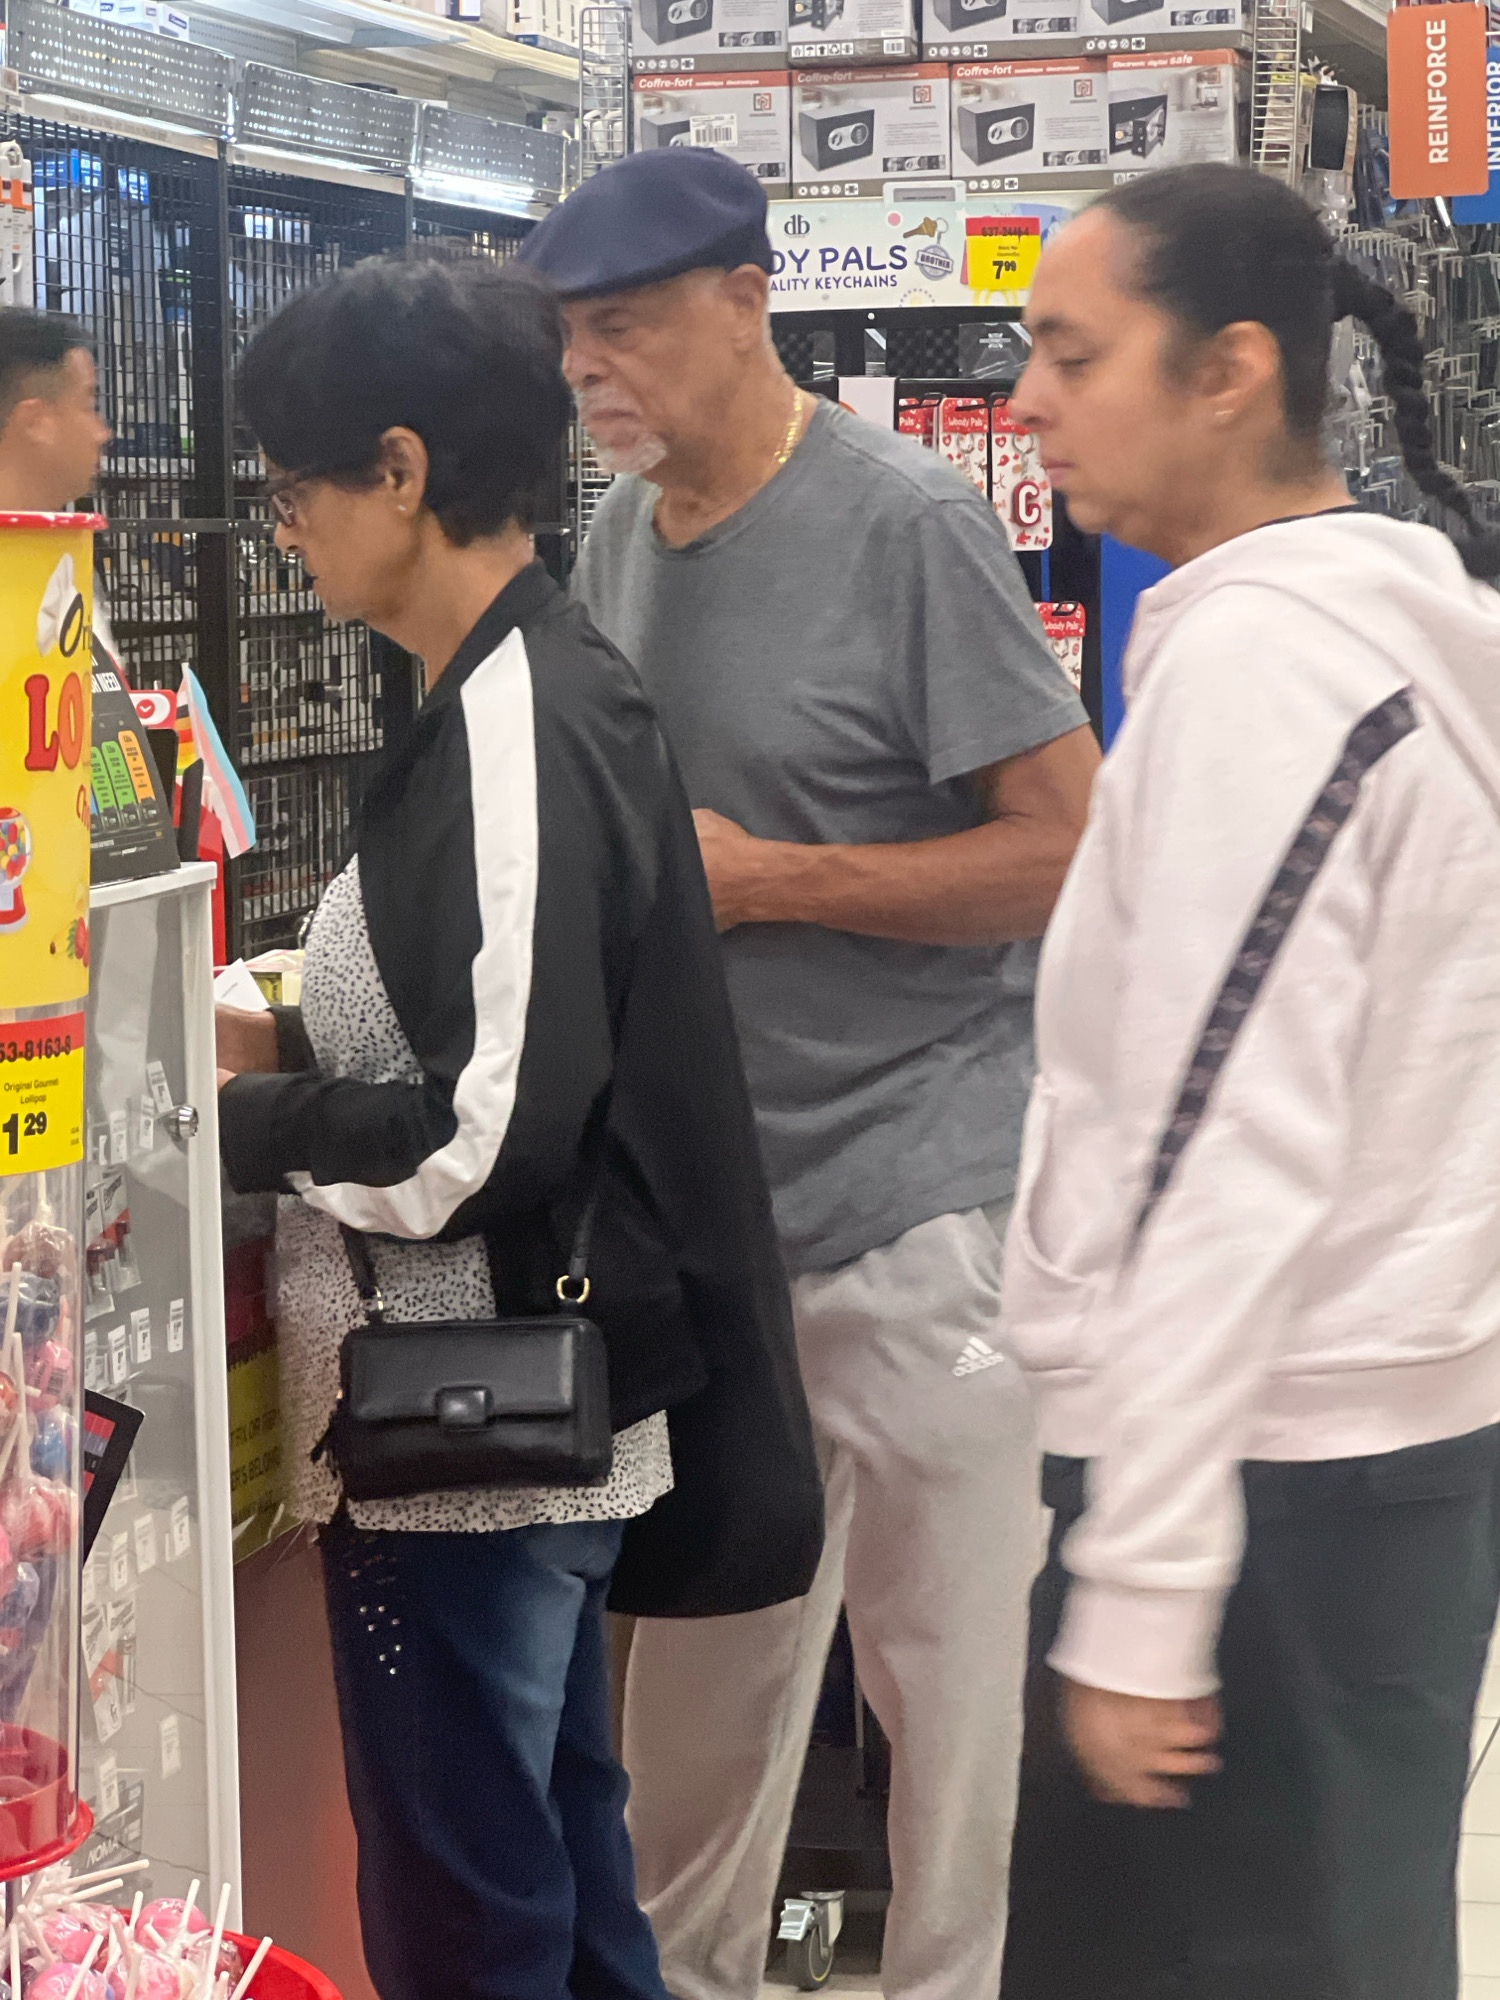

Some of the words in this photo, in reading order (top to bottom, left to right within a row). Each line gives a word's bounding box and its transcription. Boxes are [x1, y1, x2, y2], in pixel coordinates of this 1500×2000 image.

[1170, 53, 1193, 65] safe
[798, 71, 852, 83] Coffre-fort
[957, 65, 1013, 77] Coffre-fort
[638, 77, 694, 89] Coffre-fort
[1426, 19, 1448, 163] REINFORCE
[784, 214, 810, 235] db
[819, 244, 908, 272] PALS
[920, 253, 951, 269] BROTHER
[770, 278, 809, 291] ALITY
[815, 274, 898, 290] KEYCHAINS
[4, 1081, 32, 1093] Original
[20, 1094, 47, 1105] Lollipop
